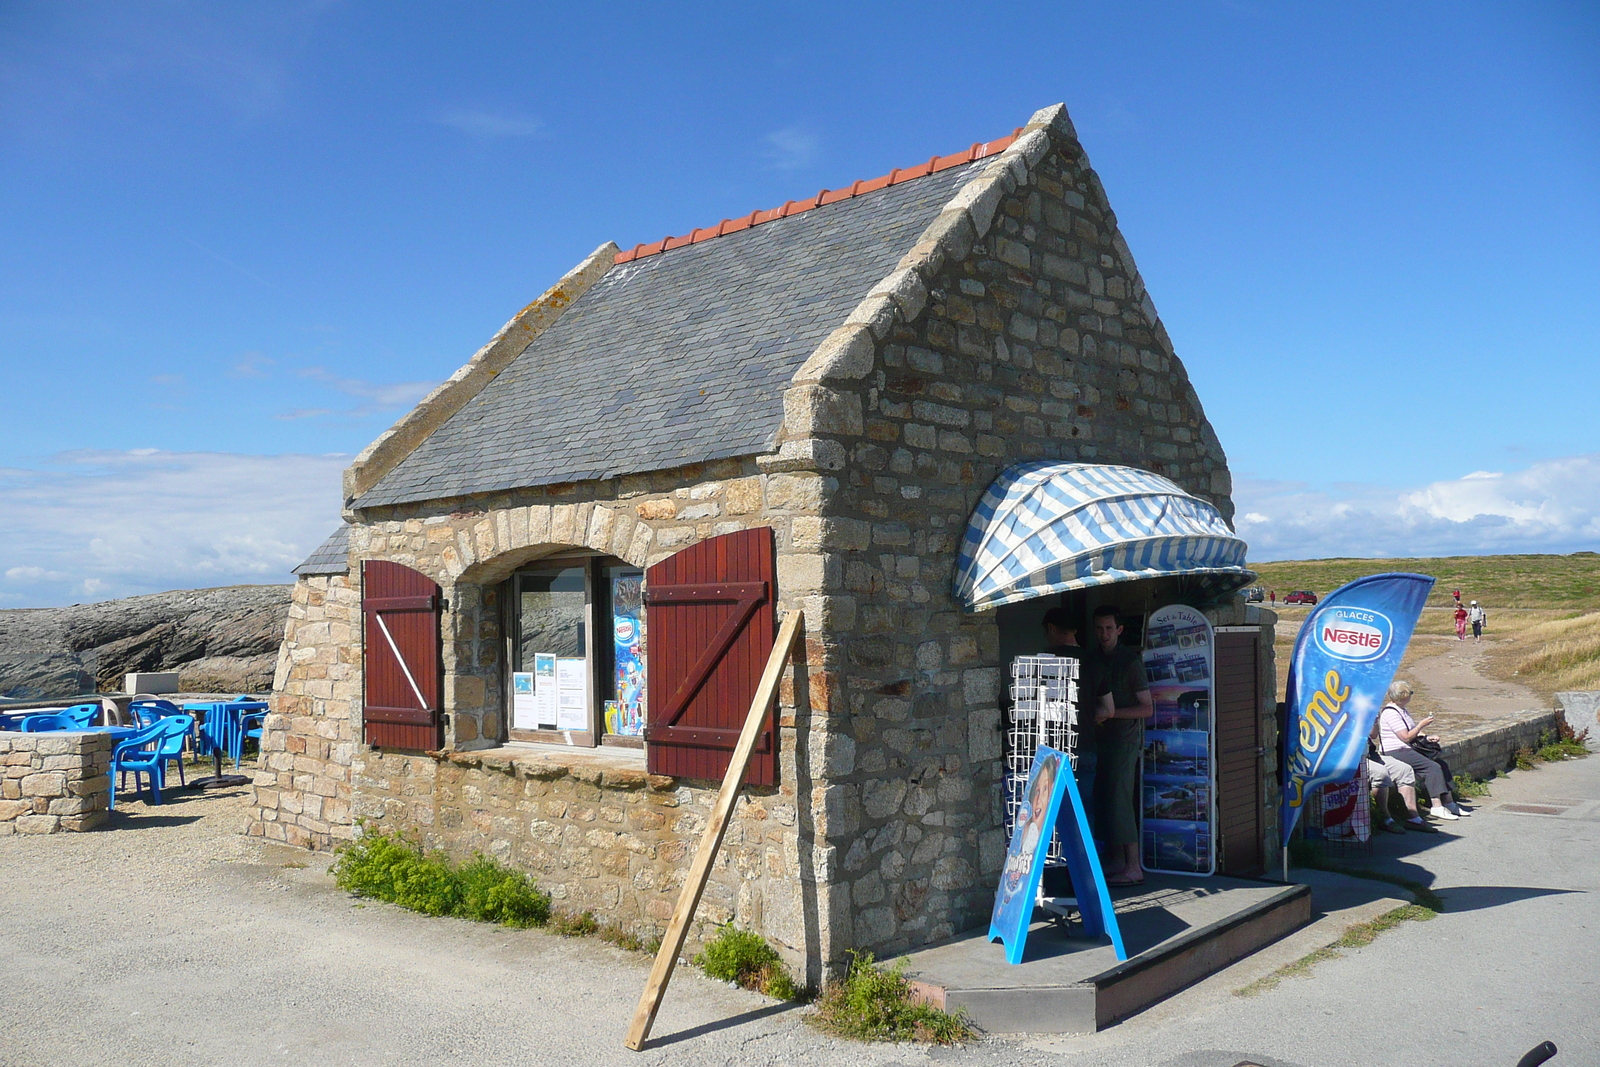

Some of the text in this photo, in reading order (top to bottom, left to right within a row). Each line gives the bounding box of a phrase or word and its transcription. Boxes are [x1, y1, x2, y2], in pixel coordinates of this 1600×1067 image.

[1157, 615, 1170, 624] Set
[1178, 611, 1198, 625] Table
[1335, 610, 1374, 622] GLACES
[1323, 627, 1381, 648] Nestlé
